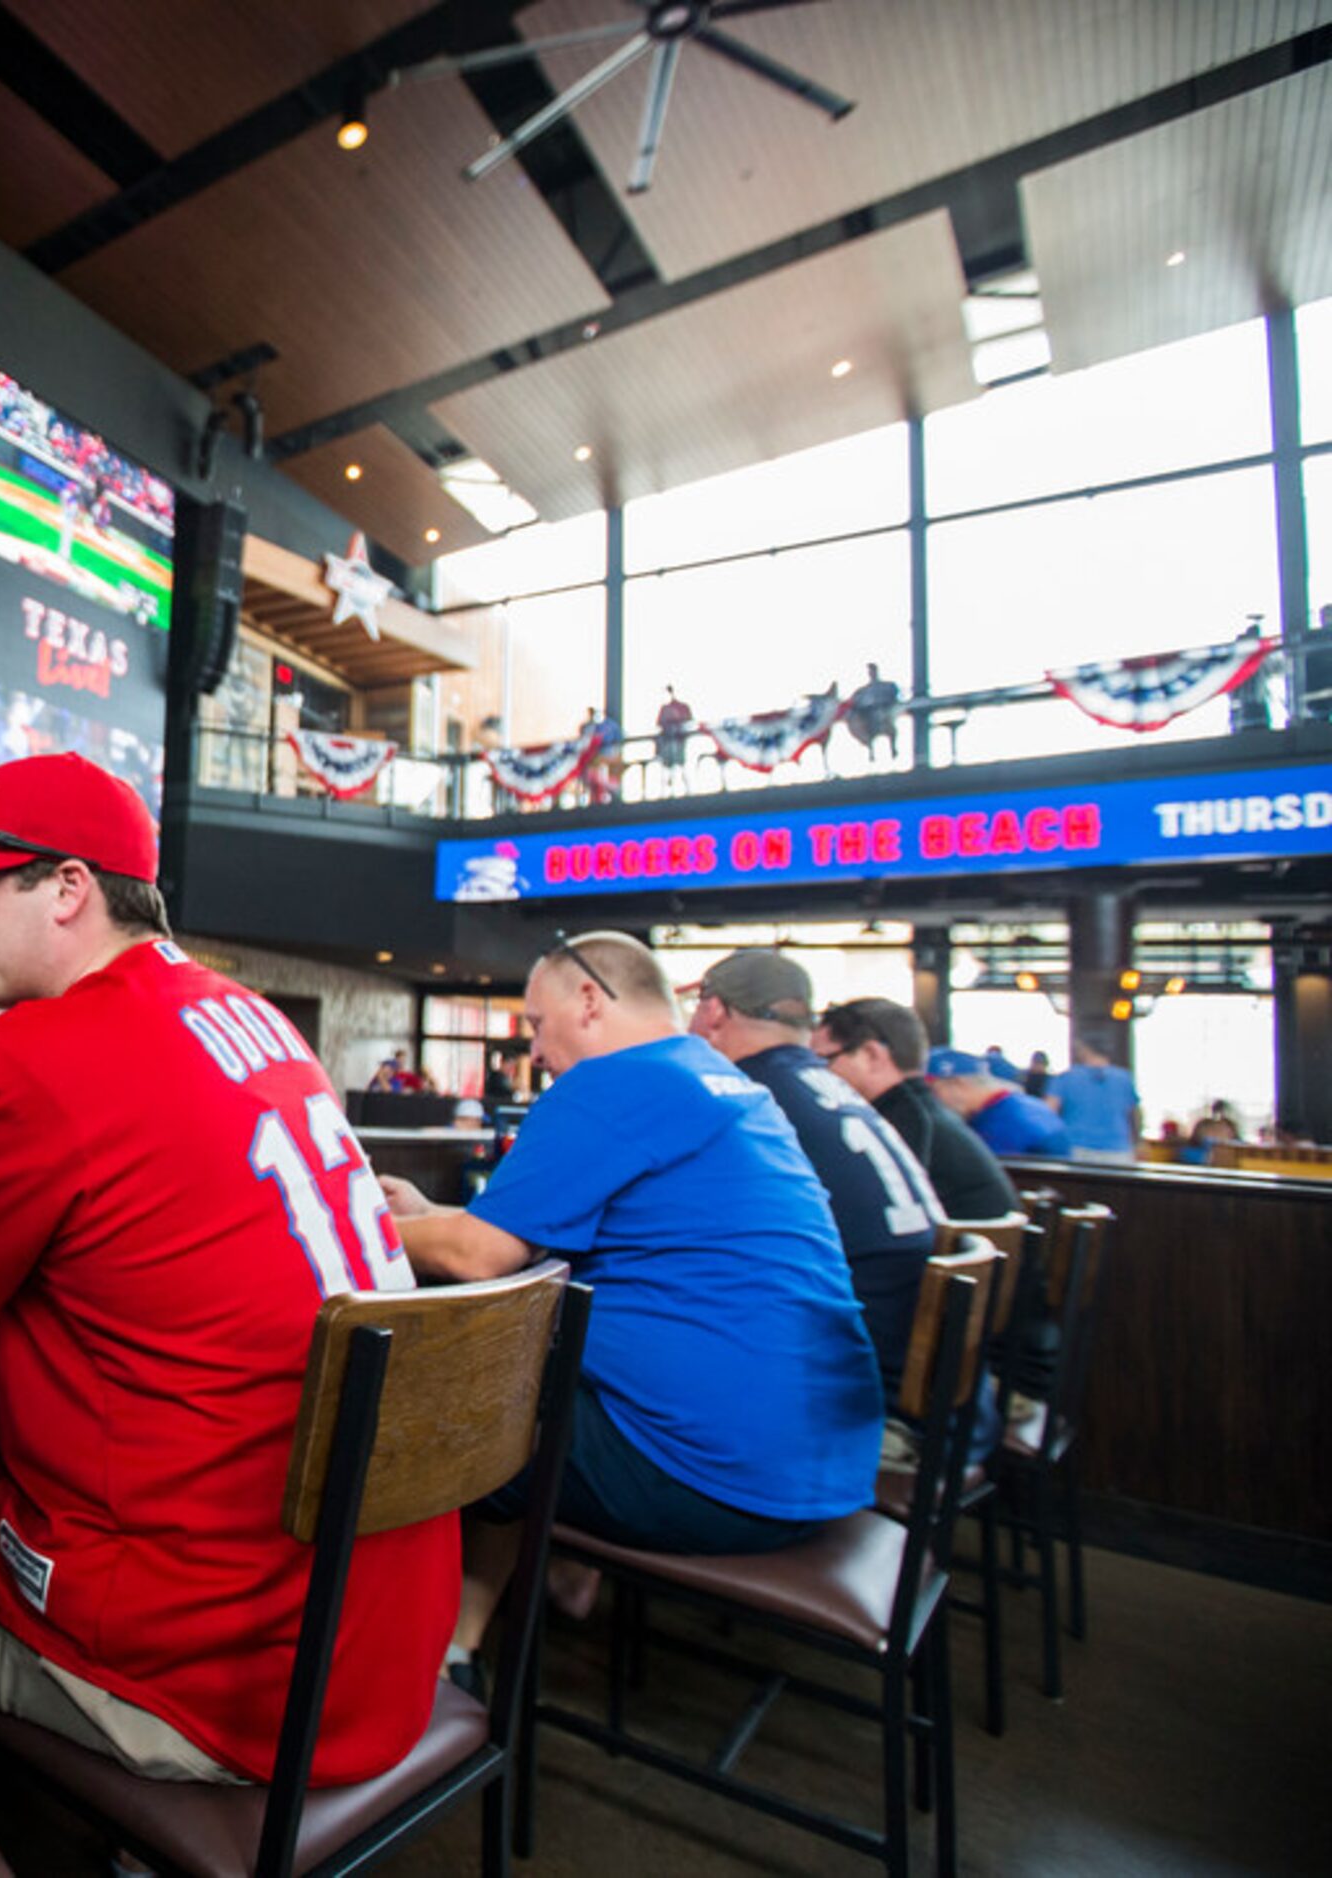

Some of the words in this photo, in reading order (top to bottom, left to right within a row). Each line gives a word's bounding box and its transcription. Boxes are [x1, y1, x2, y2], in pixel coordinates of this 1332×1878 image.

[22, 597, 128, 677] TEXAS
[544, 834, 717, 884] BURGERS
[731, 829, 792, 871] ON
[809, 818, 902, 866] THE
[919, 803, 1101, 858] BEACH
[1154, 792, 1332, 838] THURSD
[249, 1092, 418, 1300] 12
